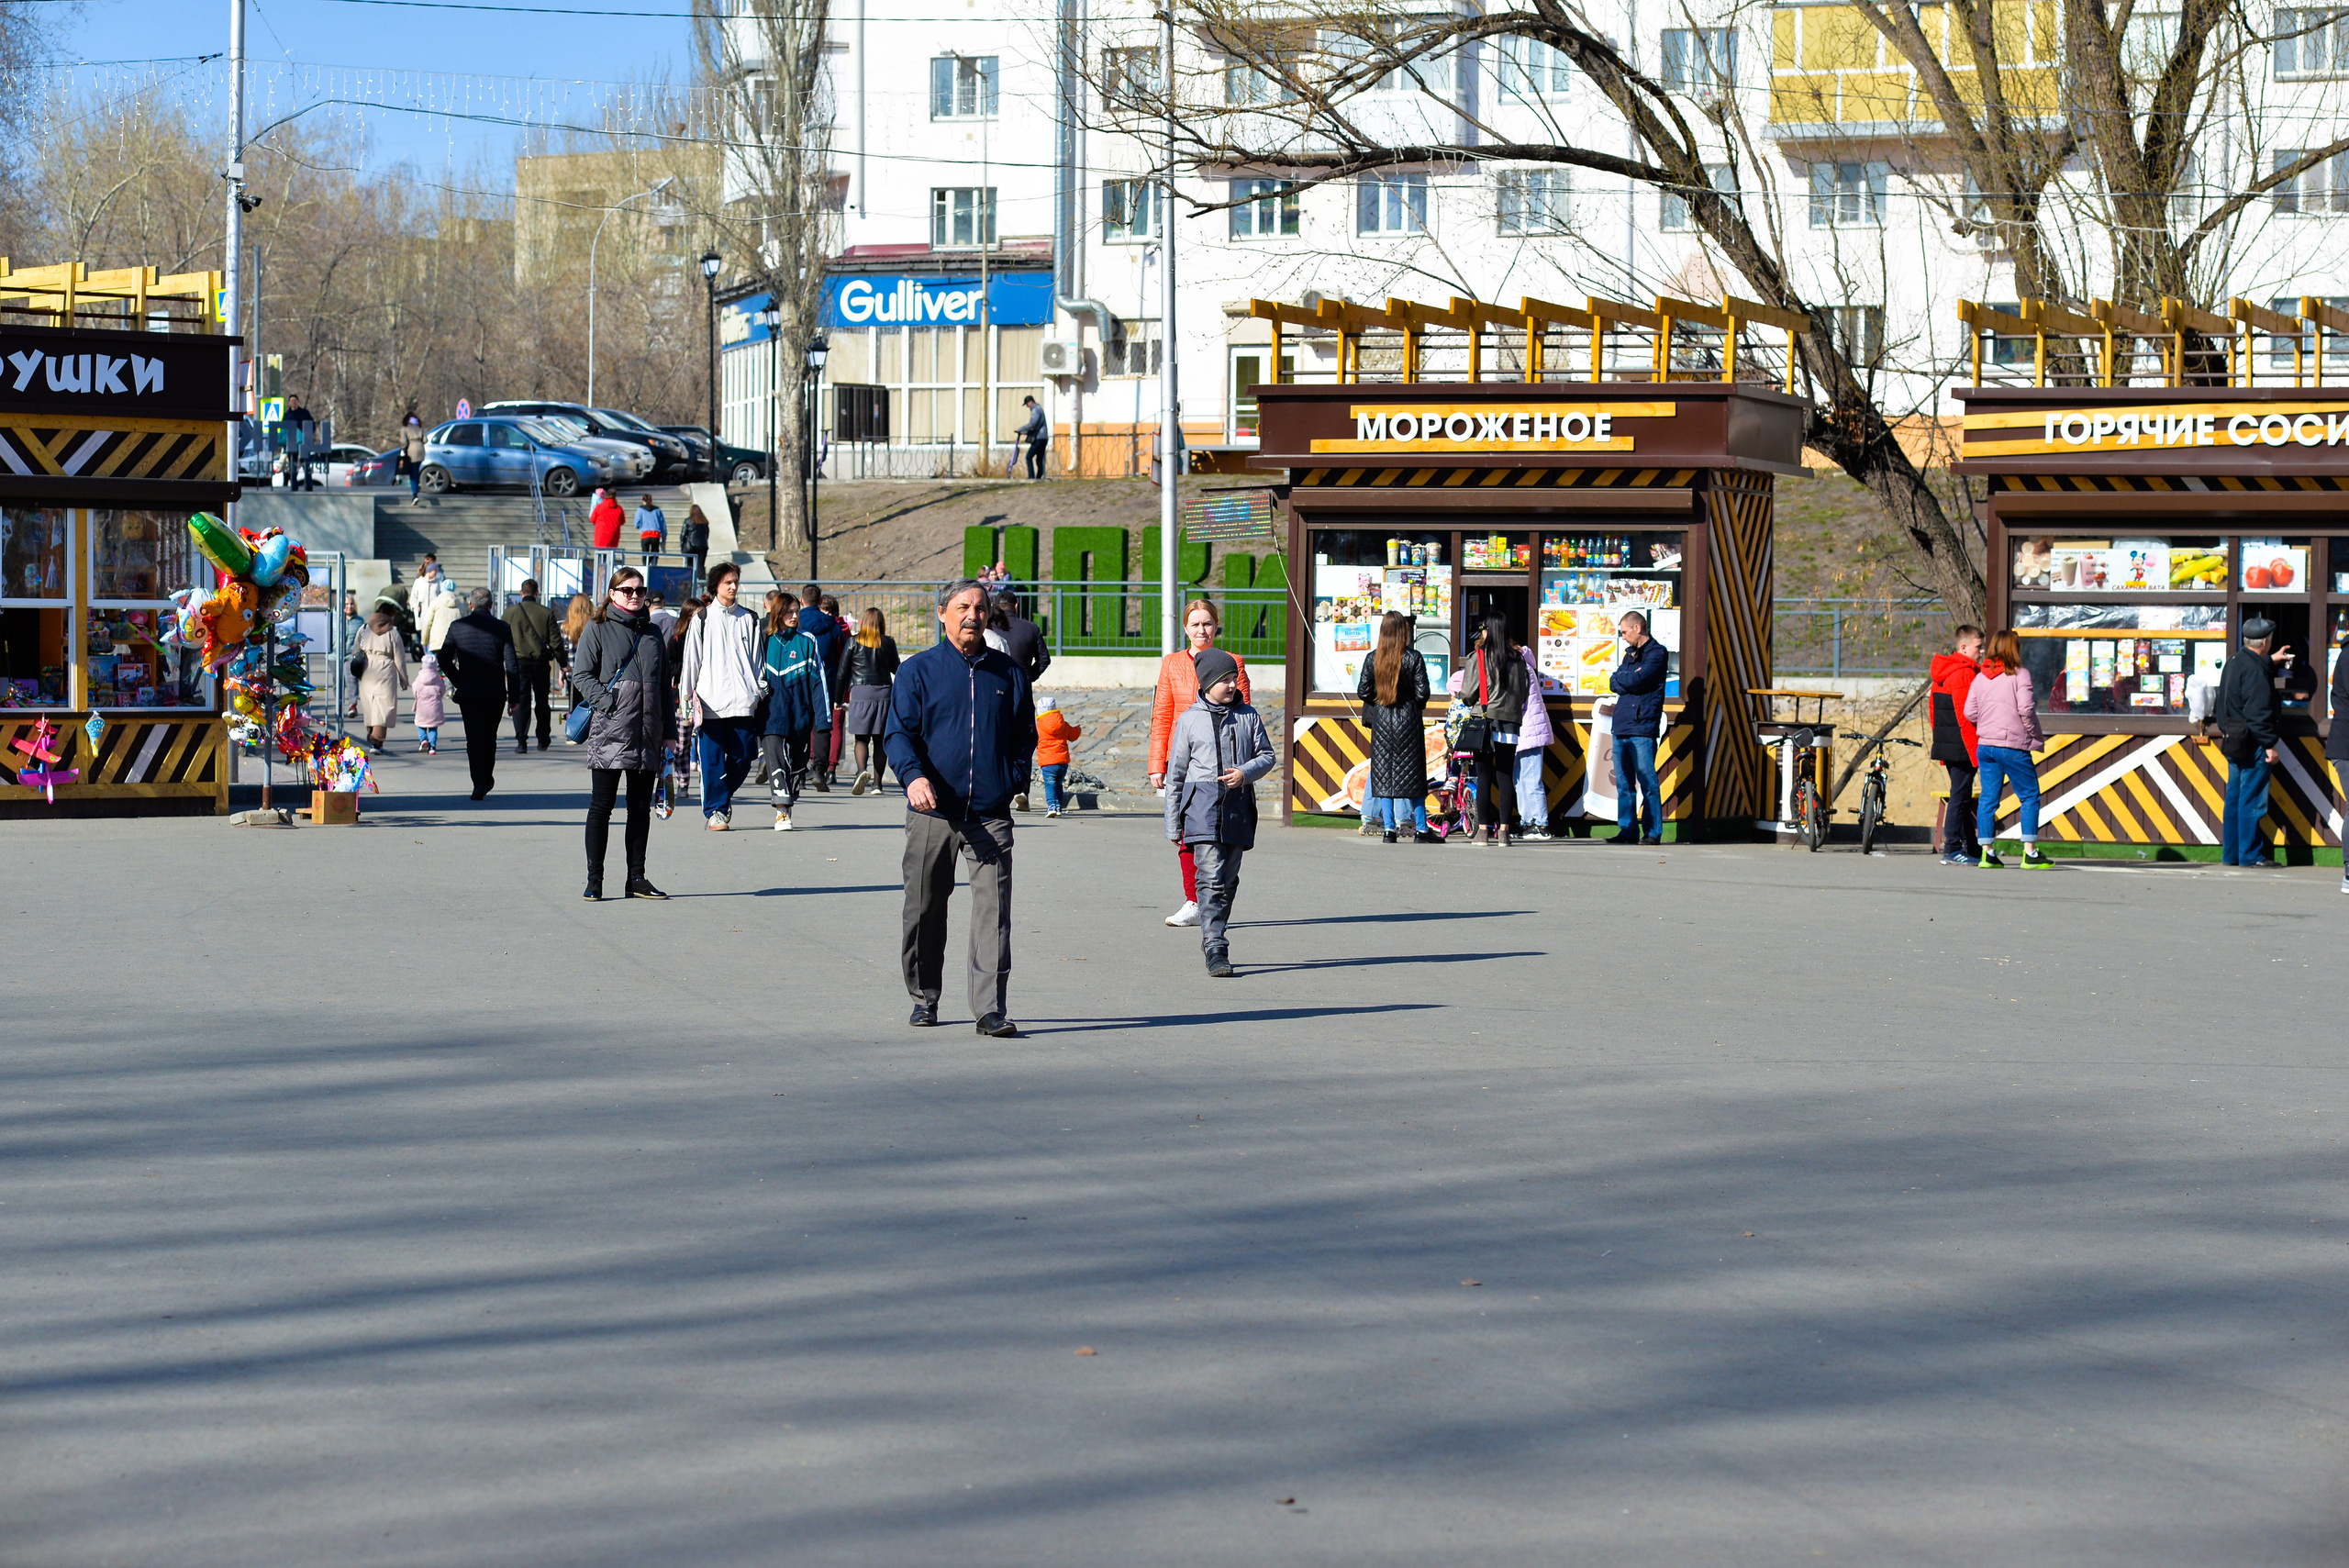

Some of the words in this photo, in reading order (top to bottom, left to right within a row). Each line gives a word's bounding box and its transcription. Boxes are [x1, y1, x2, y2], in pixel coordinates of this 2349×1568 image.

[840, 279, 983, 322] Gulliver
[1357, 411, 1612, 443] МОРОЖЕНОЕ
[2044, 413, 2215, 446] ГОРЯЧИЕ
